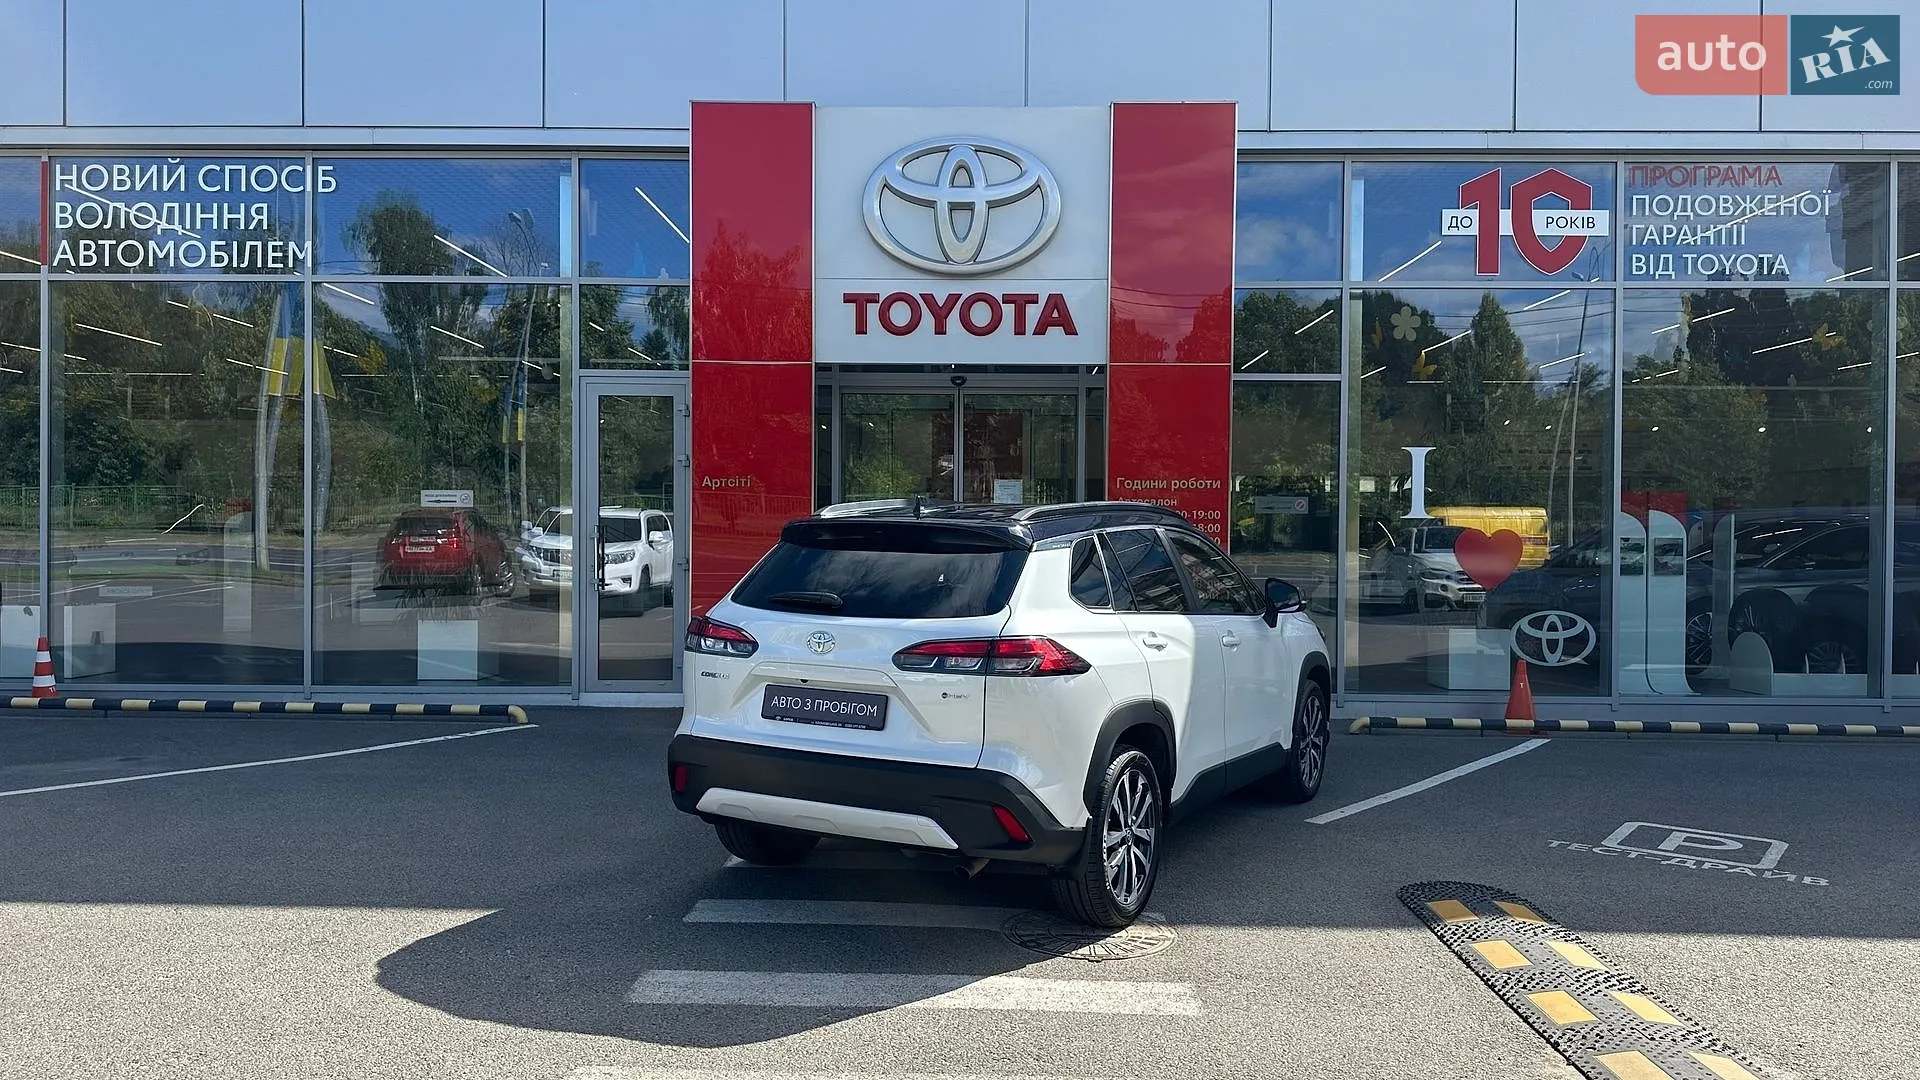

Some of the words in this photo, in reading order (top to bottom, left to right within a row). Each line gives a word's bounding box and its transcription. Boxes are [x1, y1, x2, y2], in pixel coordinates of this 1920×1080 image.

[55, 157, 185, 191] НОВИЙ
[198, 164, 337, 193] СПОСІБ
[1629, 165, 1783, 188] ПРОГРАМА
[1631, 189, 1831, 218] ПОДОВЖЕНОЇ
[55, 202, 268, 235] ВОЛОДІННЯ
[1447, 215, 1473, 231] ДО
[1545, 216, 1596, 229] РОКІВ
[1631, 219, 1747, 246] ГАРАНТІЇ
[53, 240, 312, 268] АВТОМОБІЛЕМ
[1631, 254, 1676, 279] ВІД
[1683, 254, 1790, 276] TOYOTA
[843, 291, 1079, 337] TOYOTA
[701, 475, 751, 491] Артсіті
[1116, 477, 1167, 490] Години
[1171, 477, 1221, 491] роботи
[771, 695, 802, 710] АВТО
[814, 699, 878, 717] ПРОБІГОМ
[1547, 839, 1830, 887] ТЕСТ-ДРАЙВ
